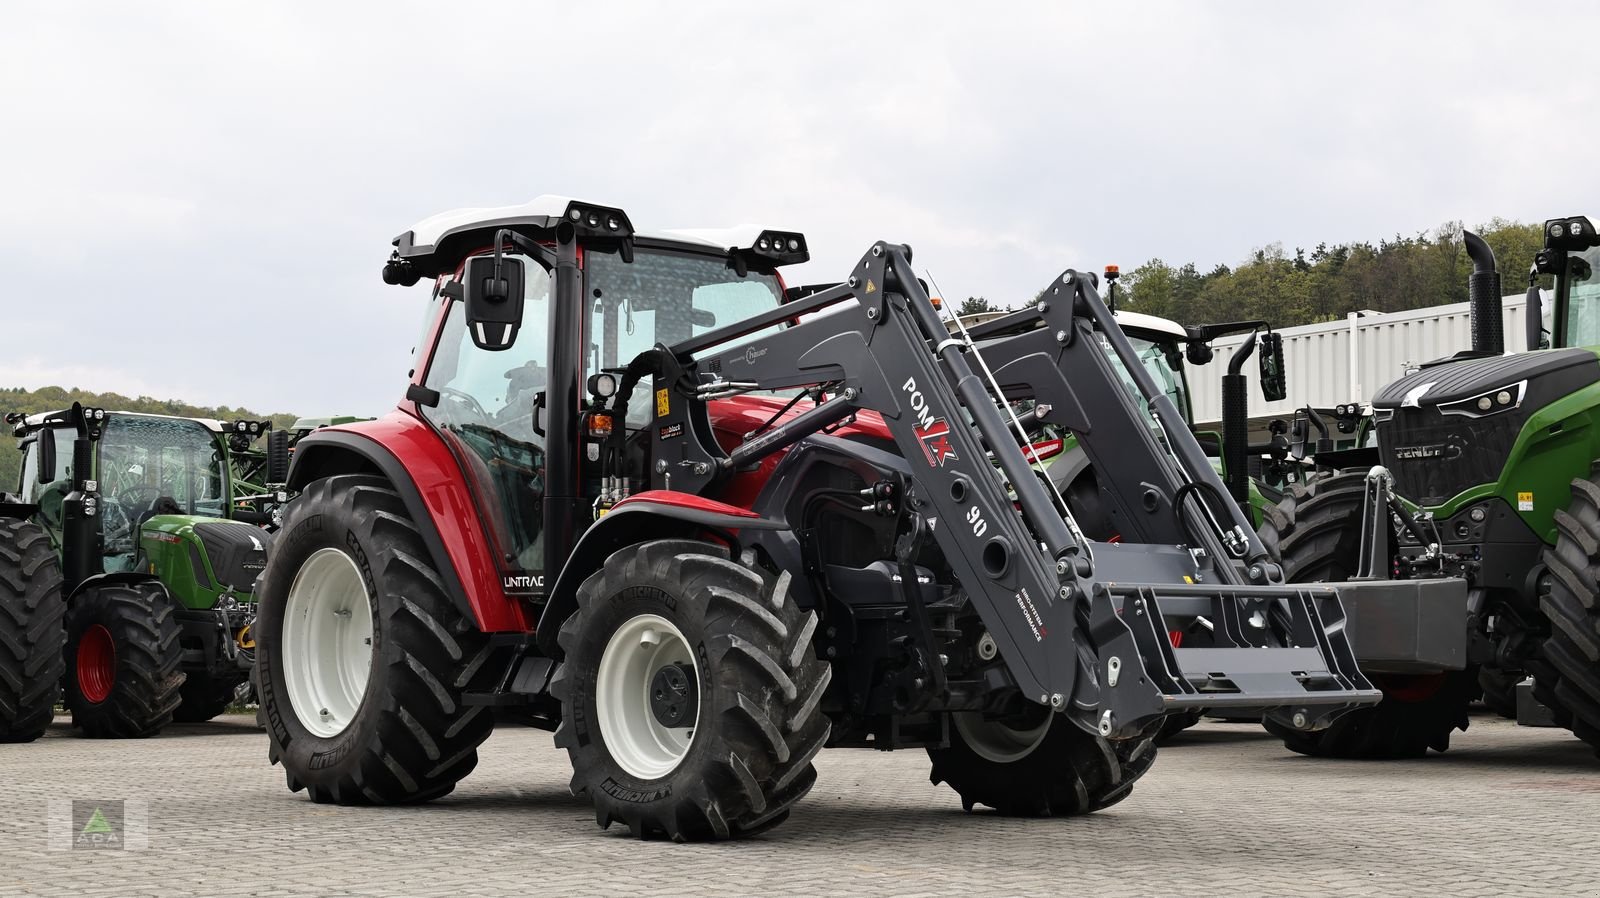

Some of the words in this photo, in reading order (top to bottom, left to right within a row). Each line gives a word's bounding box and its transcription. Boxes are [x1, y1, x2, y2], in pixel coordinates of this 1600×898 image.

[902, 376, 935, 431] POM
[966, 505, 988, 537] 90
[504, 575, 544, 588] LINTRAC
[1015, 593, 1042, 642] PERFORMANCE
[601, 779, 658, 804] MICHELIN
